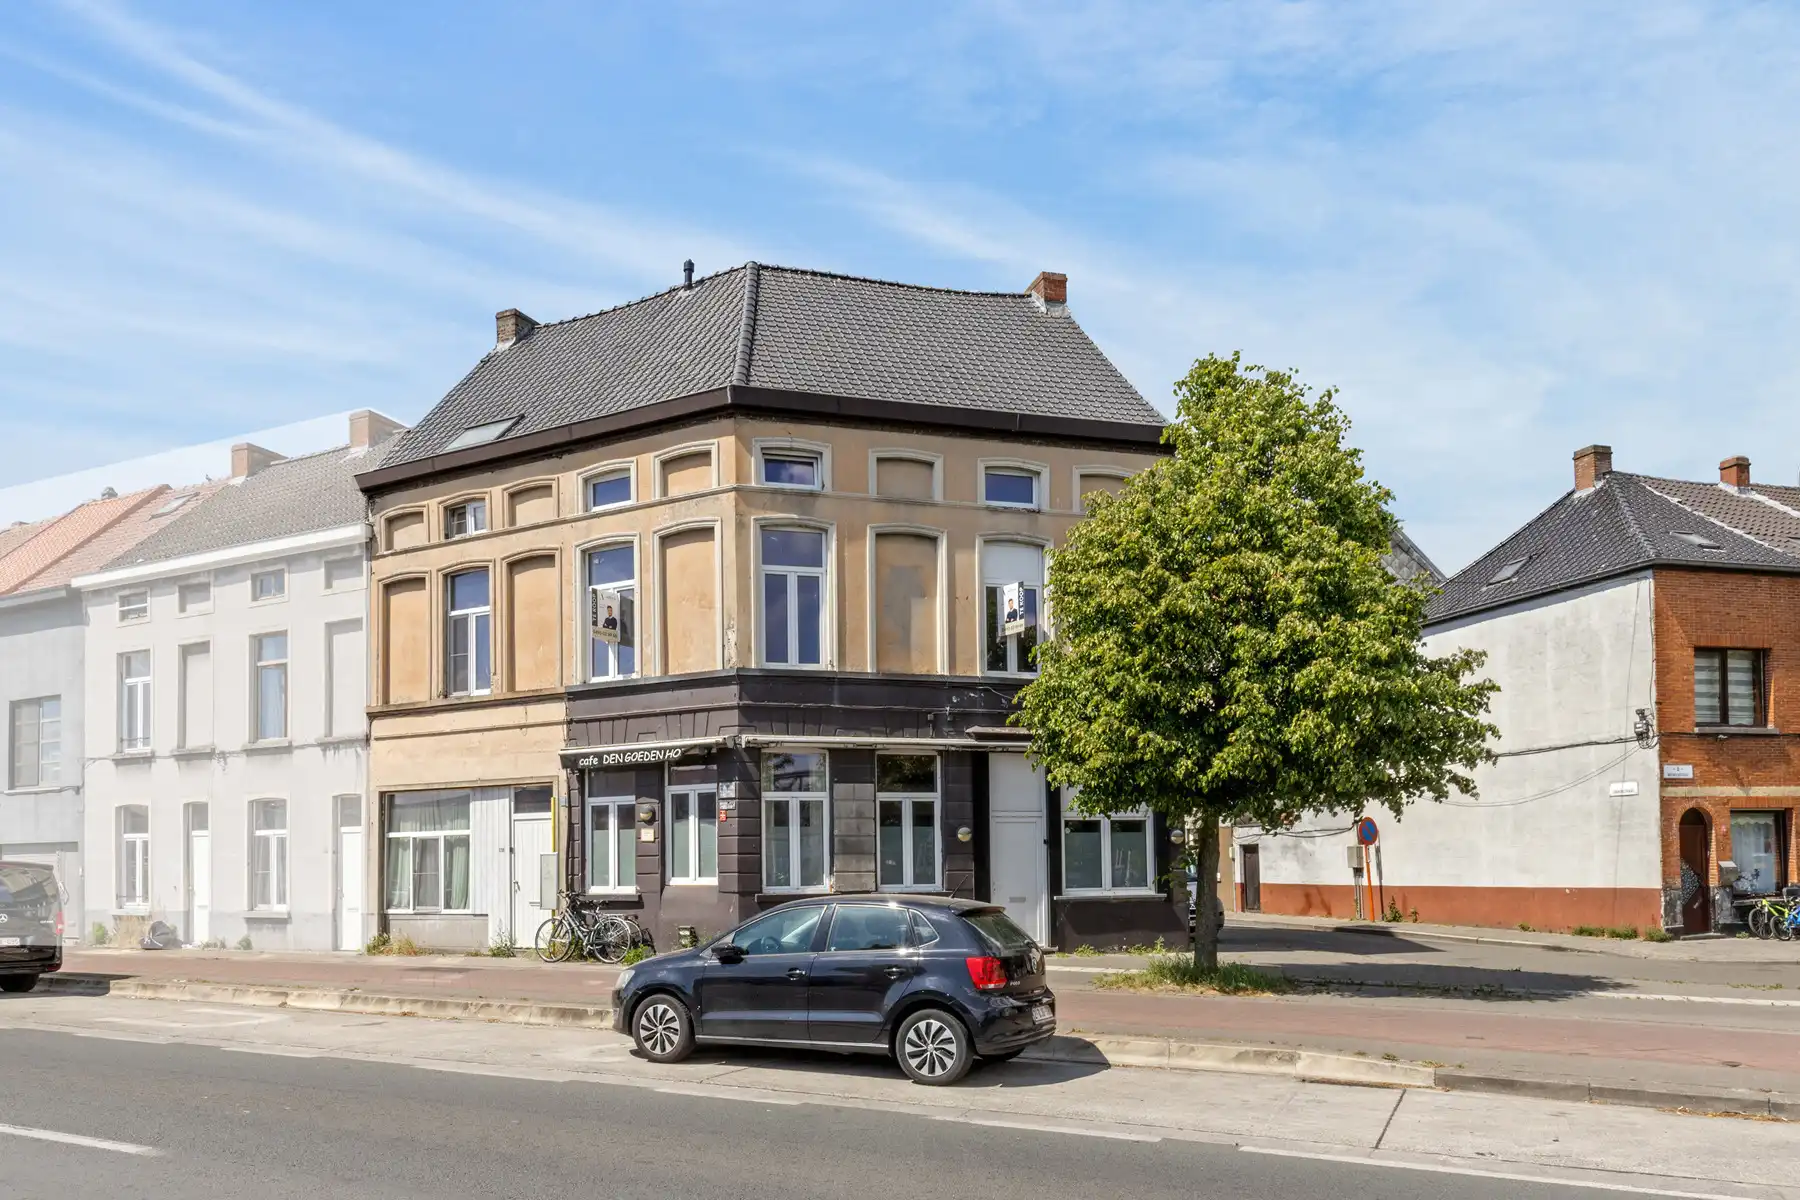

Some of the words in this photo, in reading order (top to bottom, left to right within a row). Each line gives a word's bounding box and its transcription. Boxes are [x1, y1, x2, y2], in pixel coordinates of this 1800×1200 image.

[579, 755, 598, 766] cafe
[603, 753, 623, 764] DEN
[624, 749, 663, 763] GOEDEN
